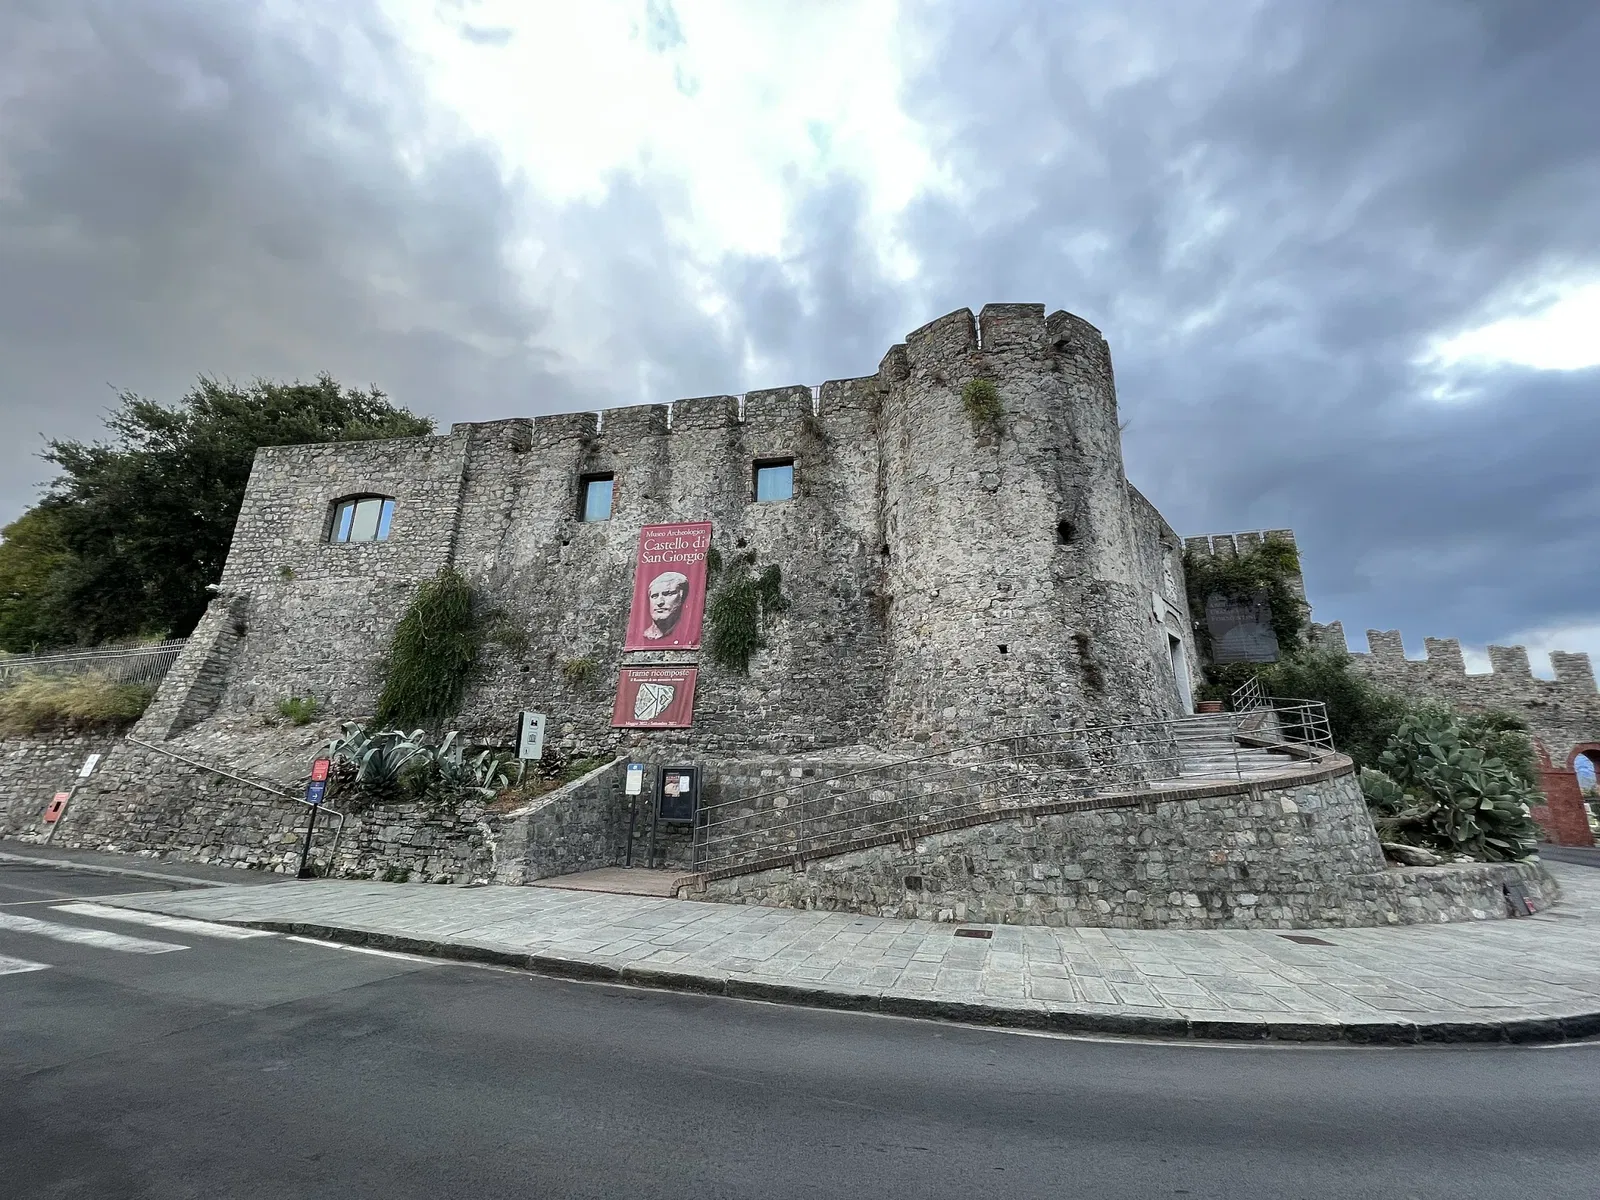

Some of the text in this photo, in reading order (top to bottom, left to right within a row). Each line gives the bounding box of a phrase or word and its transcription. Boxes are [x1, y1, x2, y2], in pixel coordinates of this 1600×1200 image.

[644, 535, 705, 551] Castello di
[641, 549, 705, 565] San Giorgio
[651, 669, 690, 678] ricomposte
